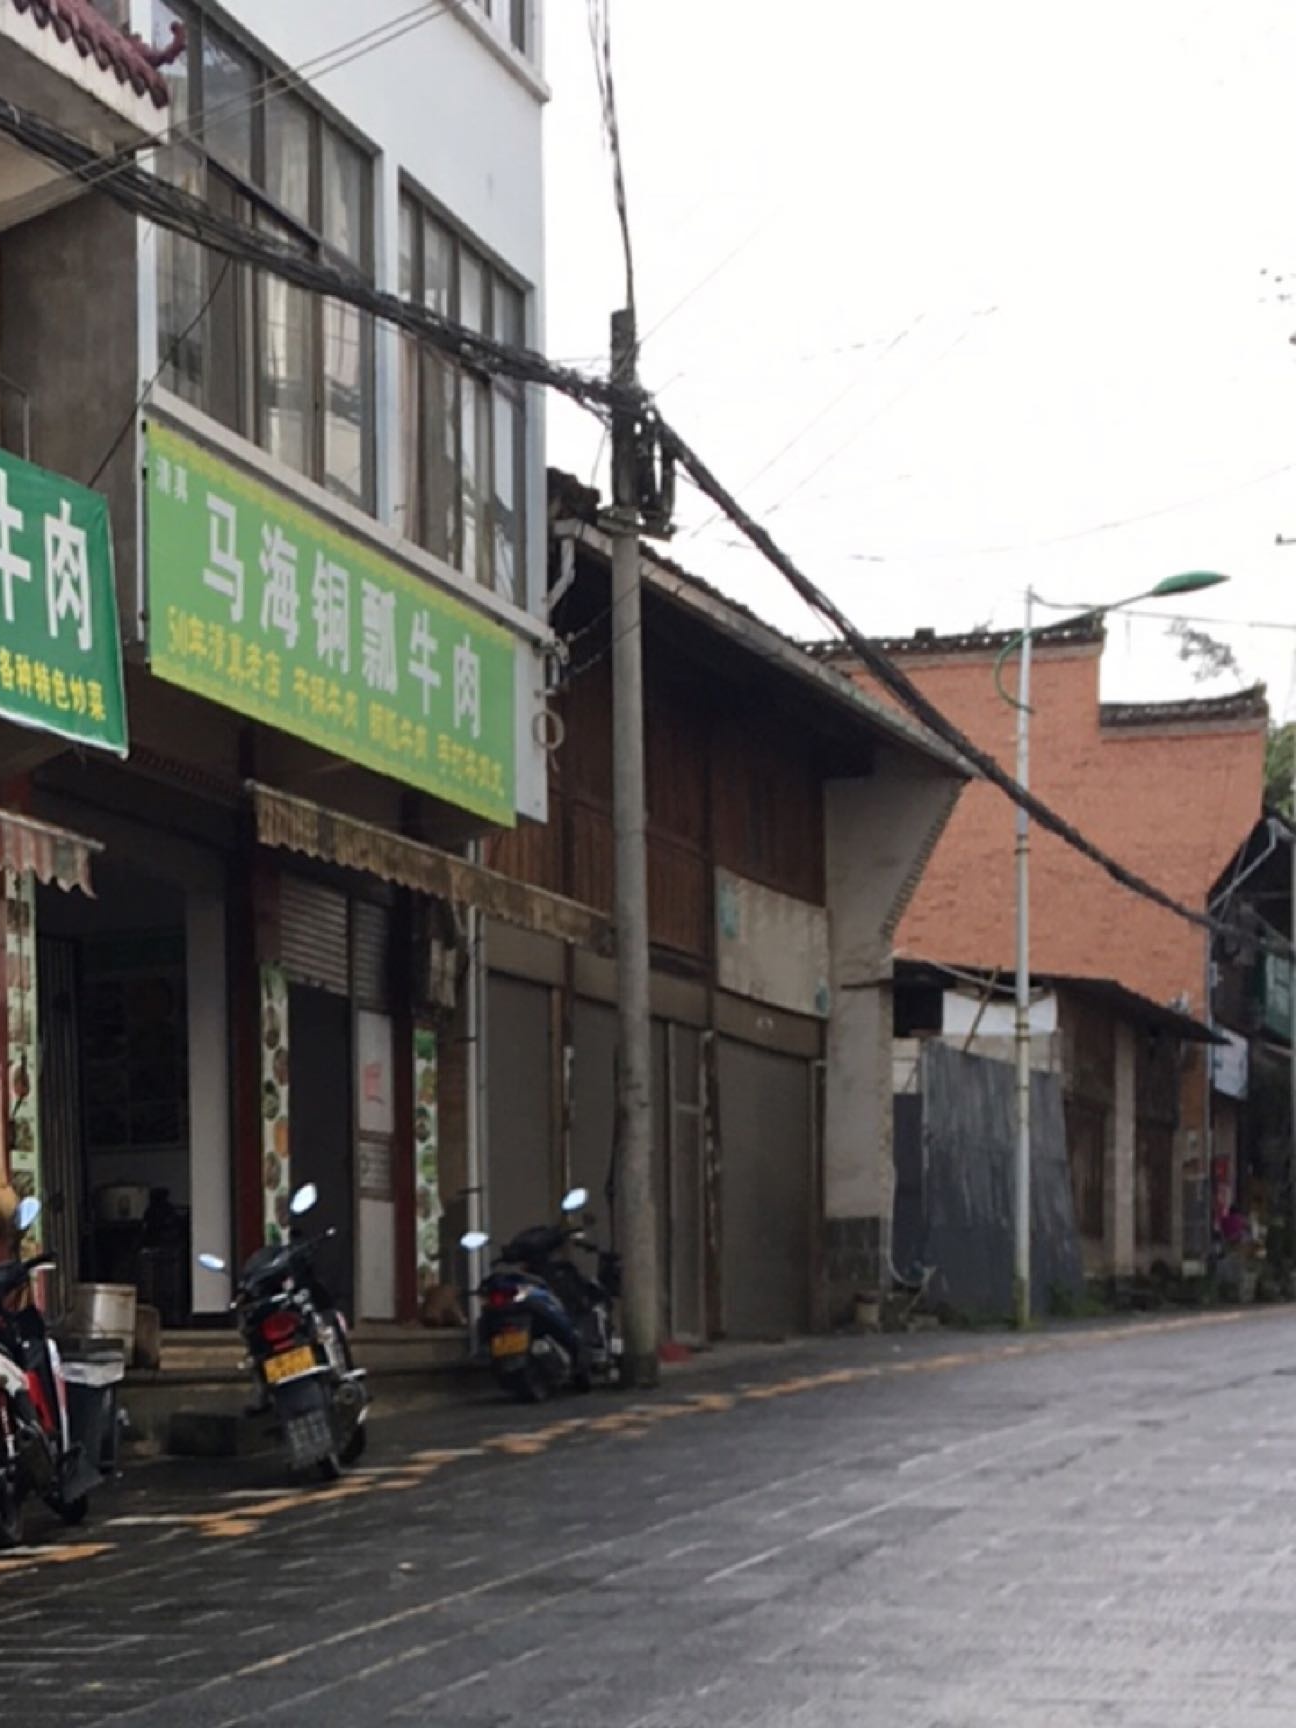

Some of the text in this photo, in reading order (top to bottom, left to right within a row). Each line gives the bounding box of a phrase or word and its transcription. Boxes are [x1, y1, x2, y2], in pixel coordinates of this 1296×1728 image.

[202, 491, 481, 740] 马海铜瓢牛肉
